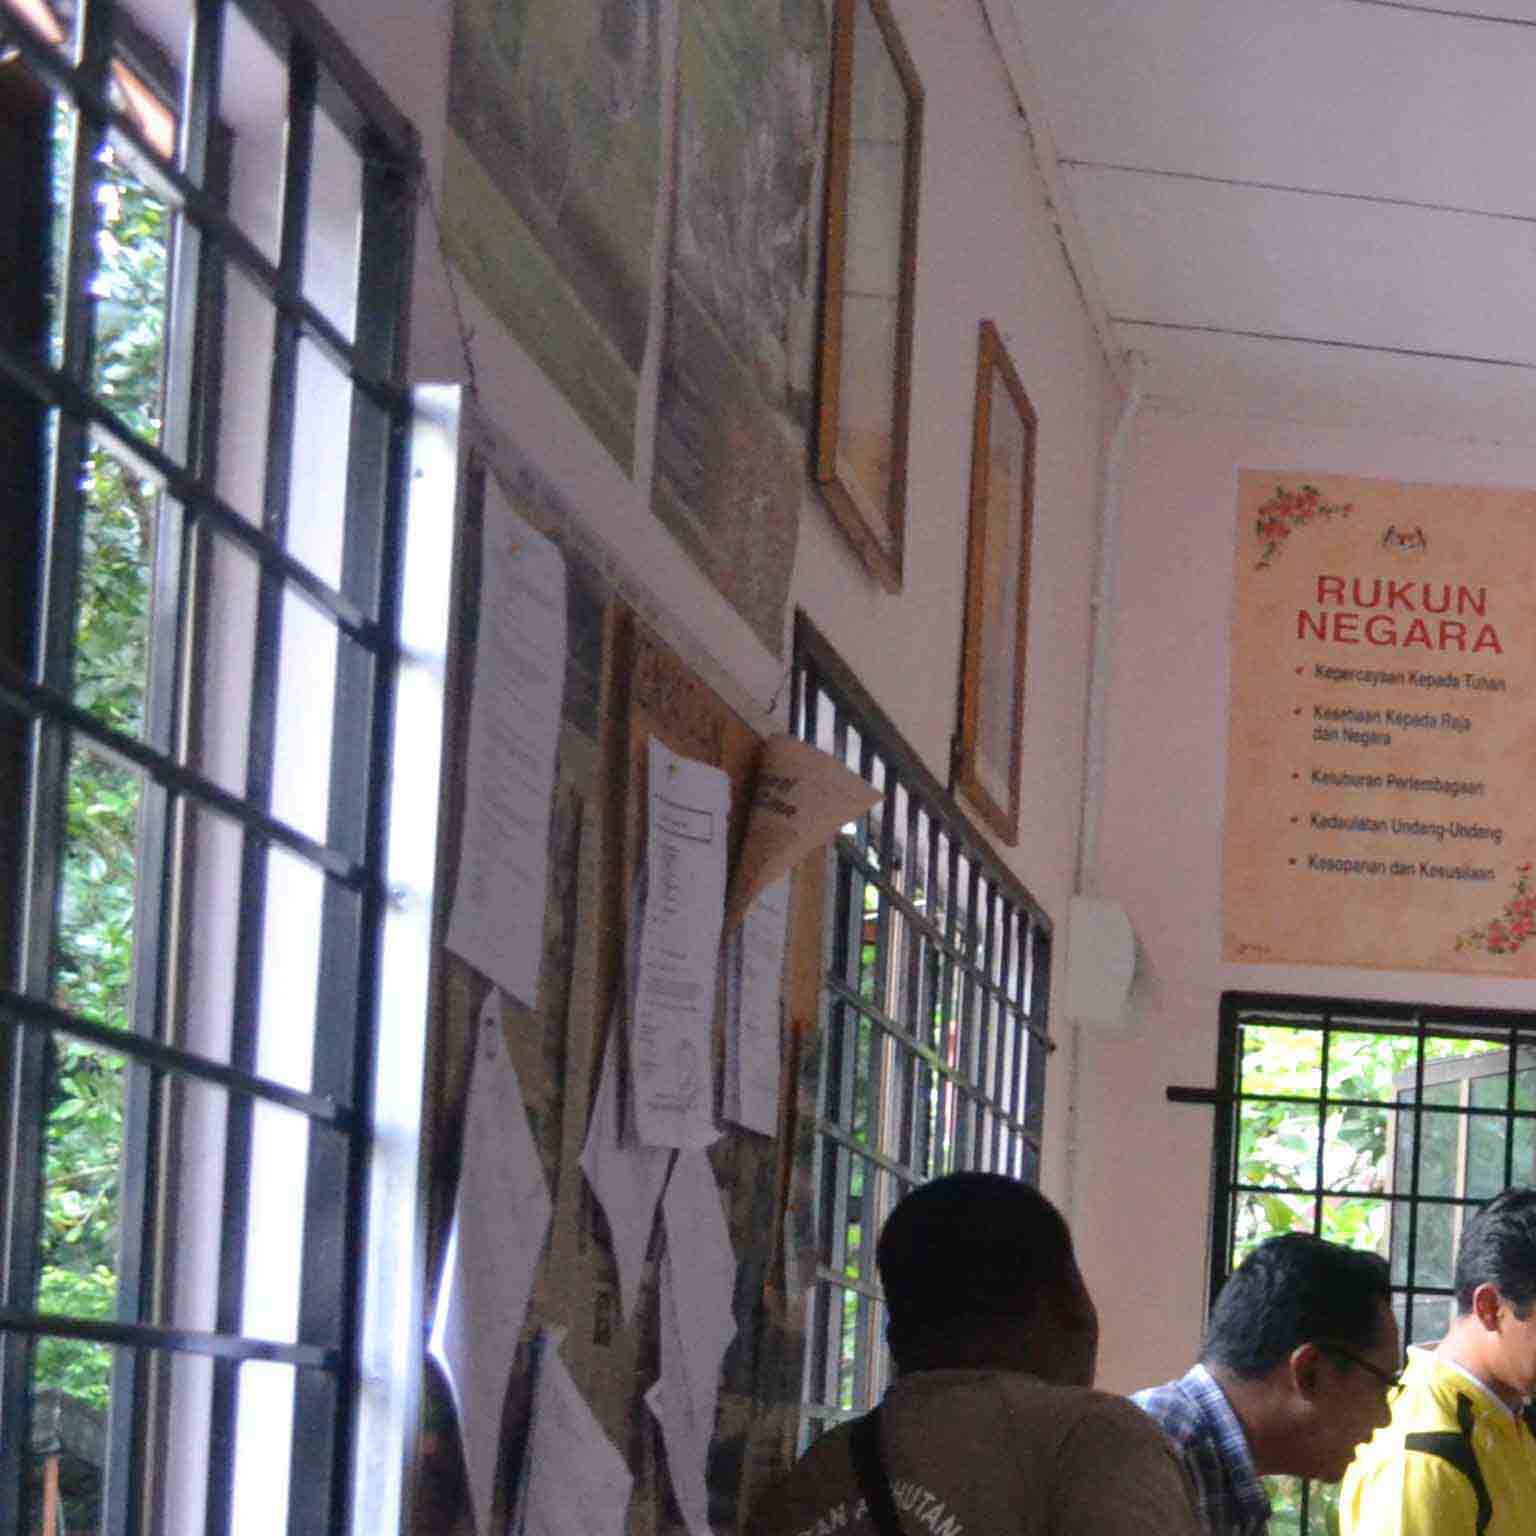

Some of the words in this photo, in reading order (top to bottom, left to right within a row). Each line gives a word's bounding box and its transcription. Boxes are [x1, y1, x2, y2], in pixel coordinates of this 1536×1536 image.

[1316, 574, 1488, 617] RUKUN
[1296, 608, 1504, 655] NEGARA
[1313, 664, 1405, 688] Kepercayaan
[1408, 670, 1460, 689] Kepada
[1464, 673, 1506, 691] Tuhan
[1313, 704, 1382, 724] Kesetiaan
[1385, 709, 1438, 731] Kepada
[1441, 712, 1472, 733] Raja
[1312, 726, 1339, 742] dan
[1343, 727, 1392, 747] Negara
[1309, 813, 1388, 833] Kedaulatan
[1307, 854, 1387, 876] Kesopanan
[1390, 861, 1416, 877] dan
